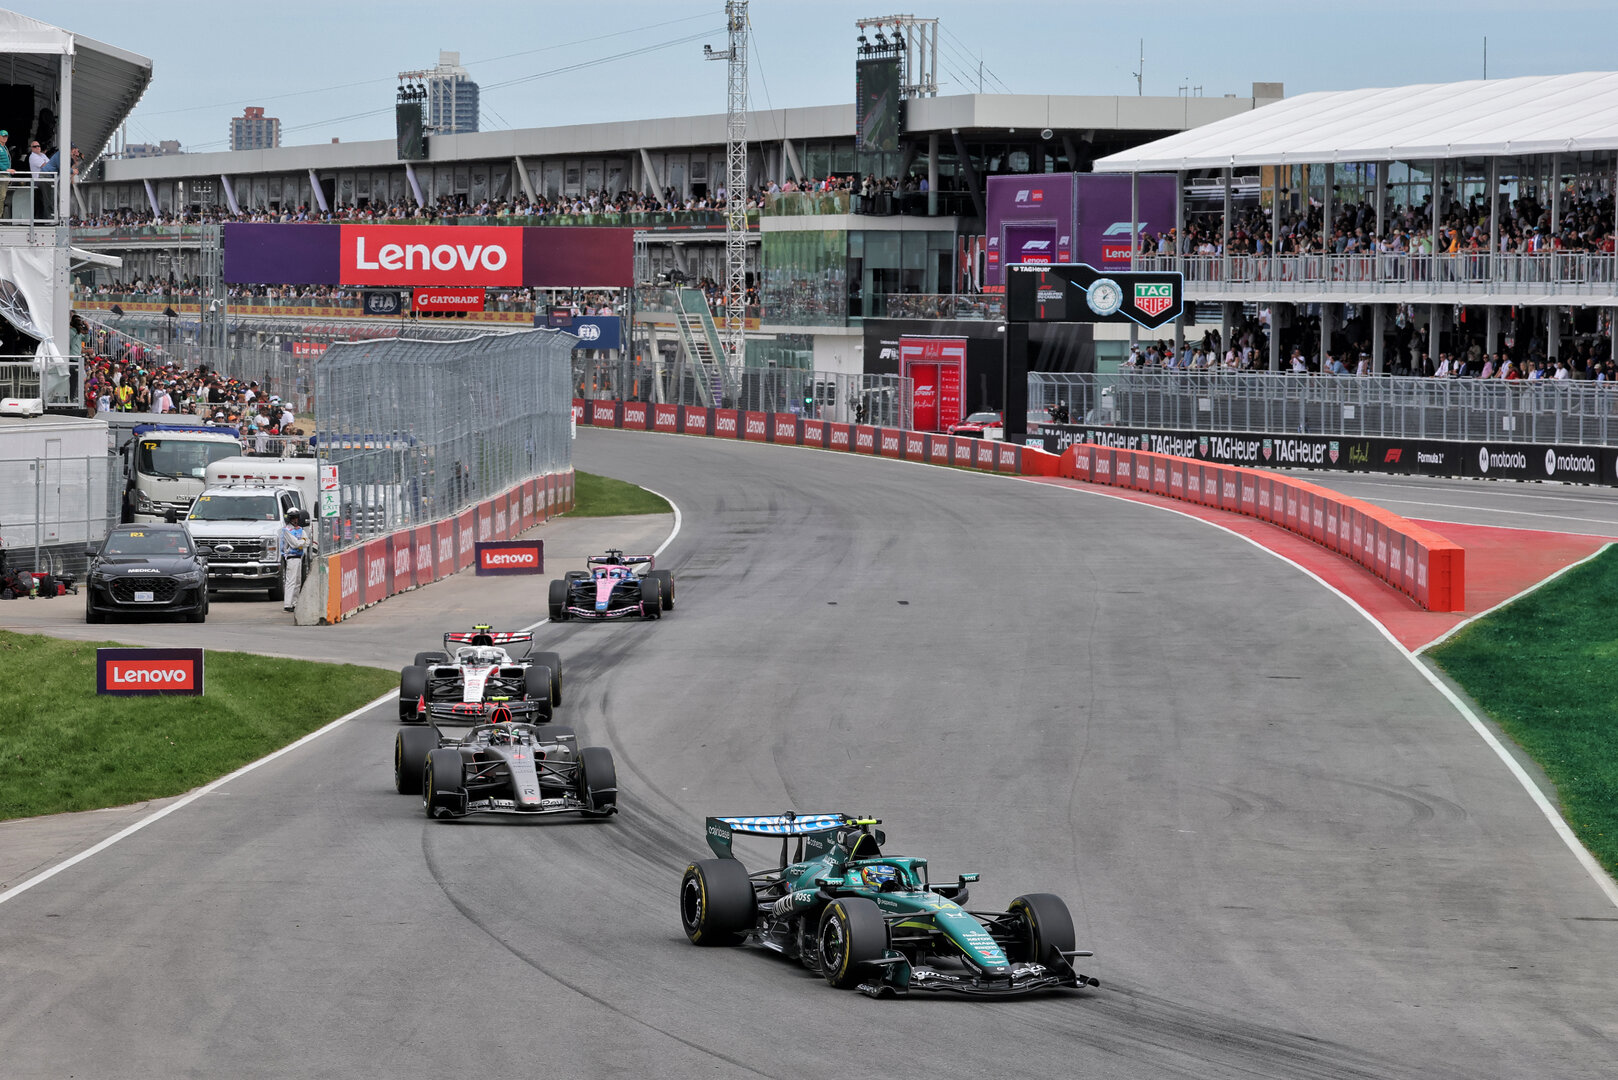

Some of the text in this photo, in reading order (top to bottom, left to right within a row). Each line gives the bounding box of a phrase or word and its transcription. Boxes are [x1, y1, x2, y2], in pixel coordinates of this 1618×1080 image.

[356, 236, 507, 271] Lenovo
[1106, 248, 1132, 258] Leno
[1138, 286, 1169, 296] TAG
[430, 296, 479, 304] GATORADE
[1136, 298, 1170, 314] HEUER
[594, 404, 614, 421] Lenovo
[624, 407, 645, 423] Lenovo
[656, 410, 676, 425] Lenovo
[686, 412, 706, 427] Lenovo
[716, 415, 736, 431] Lenovo
[746, 417, 765, 434] Lenovo
[776, 420, 795, 437] Lenovo
[805, 424, 822, 440] Lenovo
[831, 428, 848, 444] Lenovo
[857, 430, 873, 447] Lenovo
[882, 434, 898, 451] Lenovo
[1418, 452, 1438, 463] Formula
[1490, 452, 1526, 469] motorola
[1557, 454, 1595, 472] motorola
[486, 553, 534, 564] Lenovo
[114, 666, 186, 682] Lenovo
[708, 825, 730, 840] coinbase
[795, 893, 811, 902] BOSS
